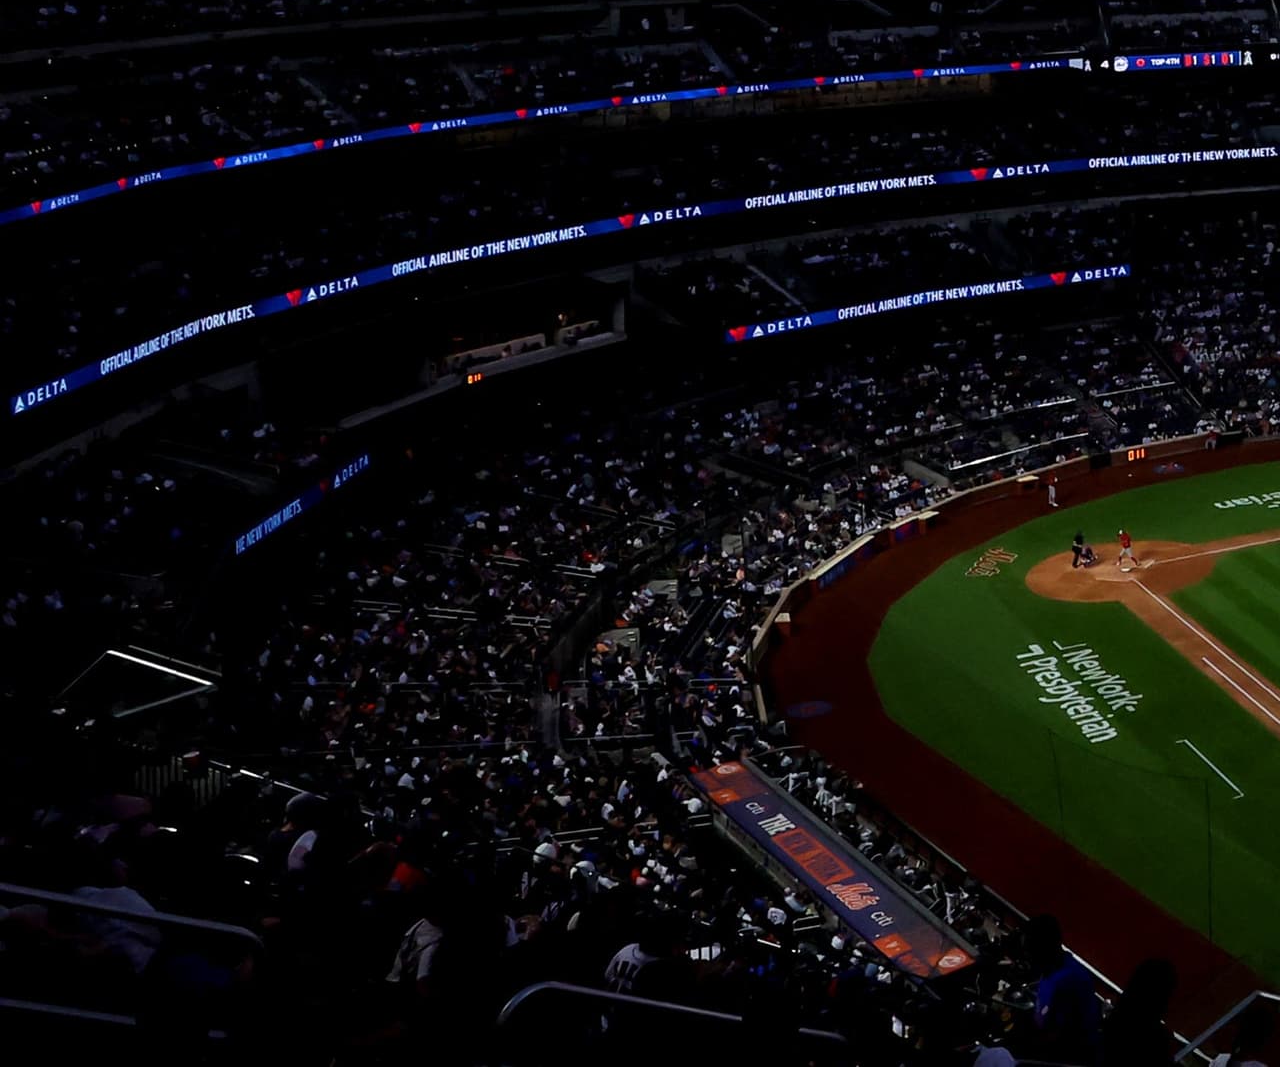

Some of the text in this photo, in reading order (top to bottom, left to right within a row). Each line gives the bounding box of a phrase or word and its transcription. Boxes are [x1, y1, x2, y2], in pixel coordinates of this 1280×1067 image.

[1007, 163, 1049, 177] DELTA
[654, 206, 701, 222] DELTA
[319, 276, 358, 297] DELTA
[392, 257, 427, 276] OFFICIAL
[429, 248, 470, 267] AIRLINE
[471, 245, 485, 258] OF
[486, 241, 505, 255] THE
[507, 236, 530, 251] NEW
[531, 231, 558, 245] YORK
[1085, 266, 1126, 280] DELTA
[767, 316, 812, 334] DELTA
[838, 303, 877, 319] OFFICIAL
[878, 296, 912, 312] AIRLINE
[912, 293, 924, 304] OF
[925, 290, 944, 302] THE
[945, 287, 968, 299] NEW
[969, 284, 995, 295] YORK
[28, 378, 68, 406] DELTA
[1019, 656, 1118, 743] Presbyterian
[758, 813, 797, 836] THE
